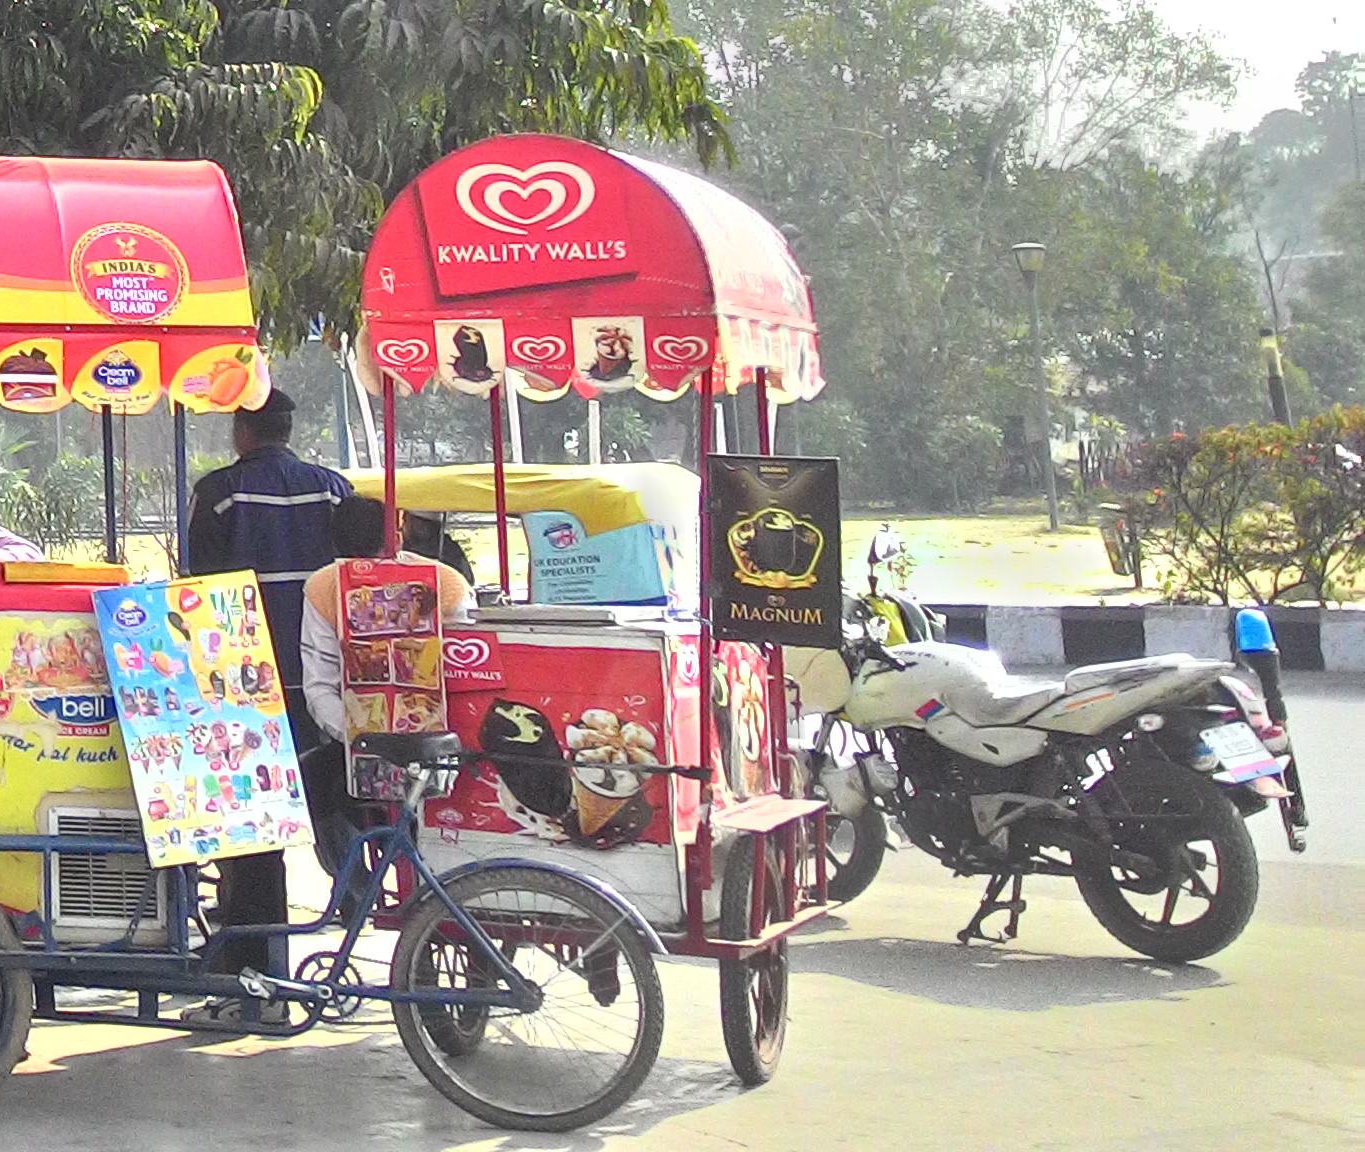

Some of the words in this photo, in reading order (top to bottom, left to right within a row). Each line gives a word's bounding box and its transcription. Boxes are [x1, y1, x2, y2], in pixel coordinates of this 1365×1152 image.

[437, 243, 540, 264] KWALITY
[546, 240, 627, 260] WALL'S
[112, 276, 149, 289] MOST
[95, 287, 168, 302] PROMISING
[109, 301, 157, 314] BRAND
[97, 365, 136, 378] Cream
[106, 375, 129, 386] bell
[547, 555, 601, 566] EDUCATION
[541, 566, 596, 577] SPECIALISTS
[730, 601, 824, 626] MAGNUM
[61, 696, 106, 718] bell
[76, 745, 119, 764] kuch
